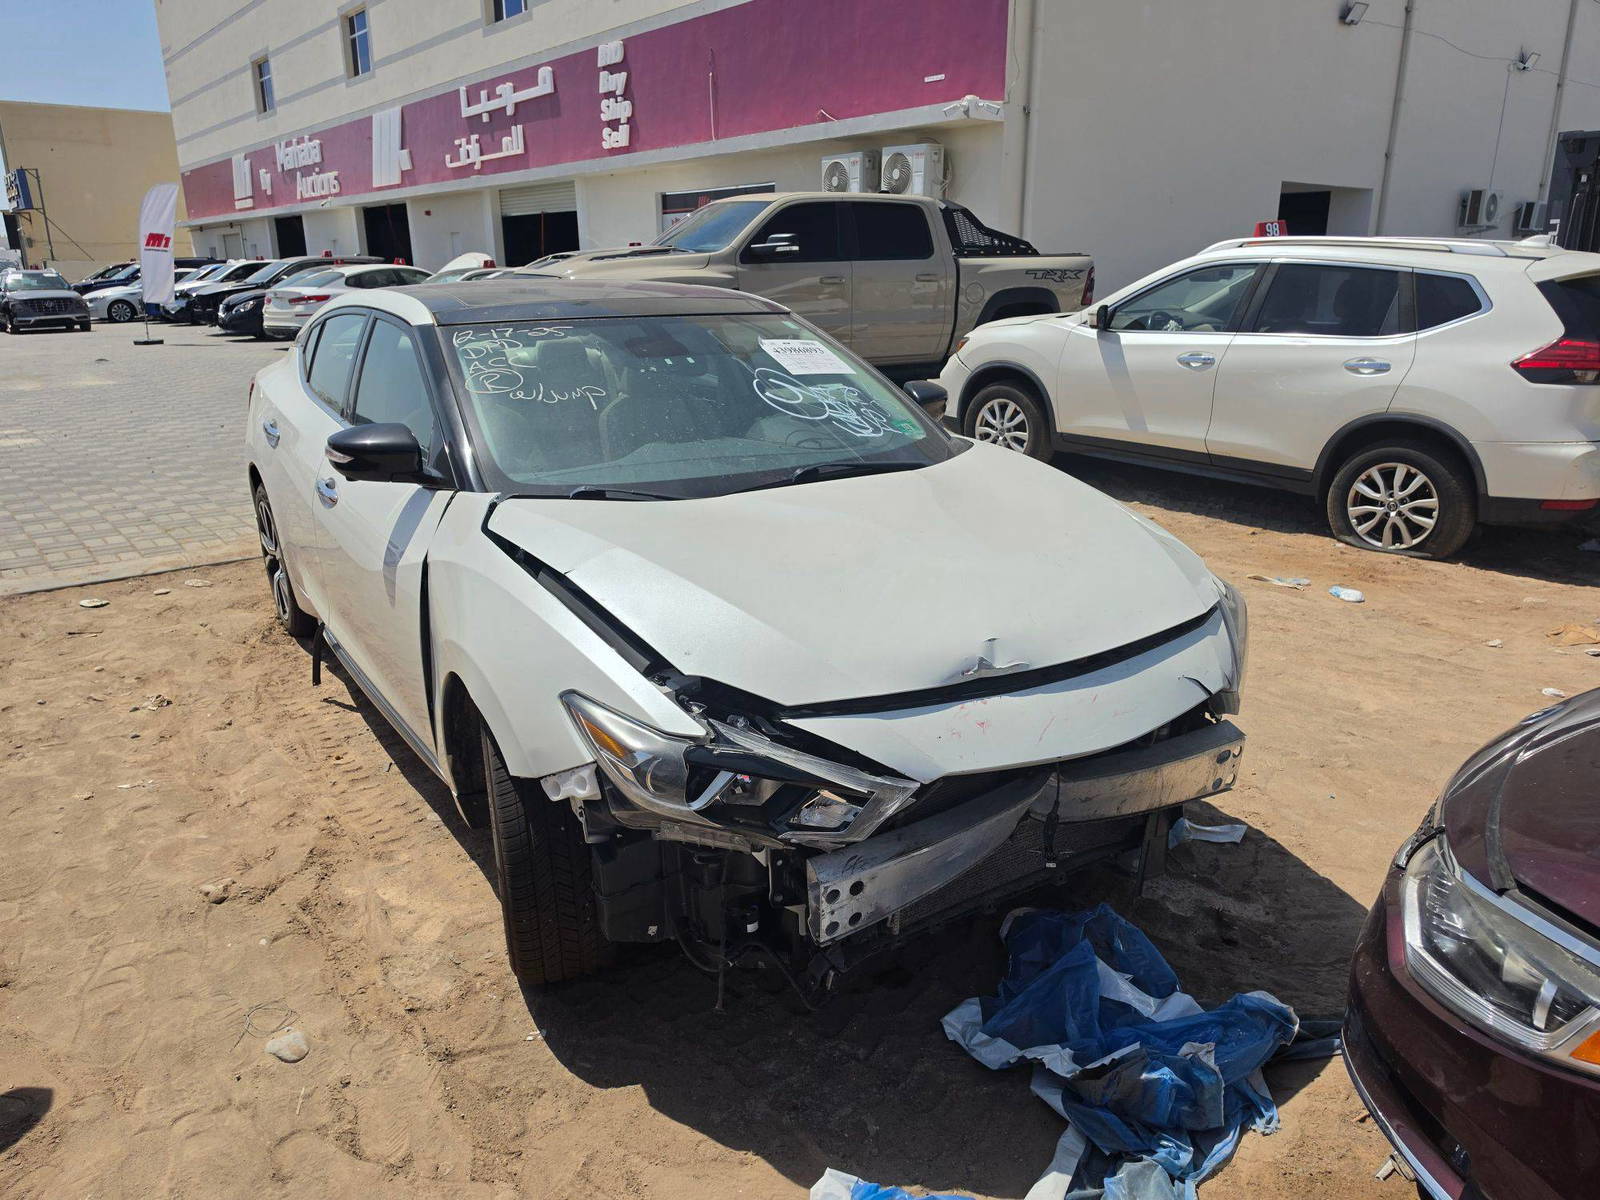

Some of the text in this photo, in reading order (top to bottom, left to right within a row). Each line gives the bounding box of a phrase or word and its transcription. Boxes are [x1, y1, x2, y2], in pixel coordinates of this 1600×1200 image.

[600, 96, 633, 124] Ship
[602, 124, 630, 150] Sell
[296, 167, 341, 200] Auctions
[1265, 222, 1280, 237] 98
[1025, 269, 1084, 283] TRX
